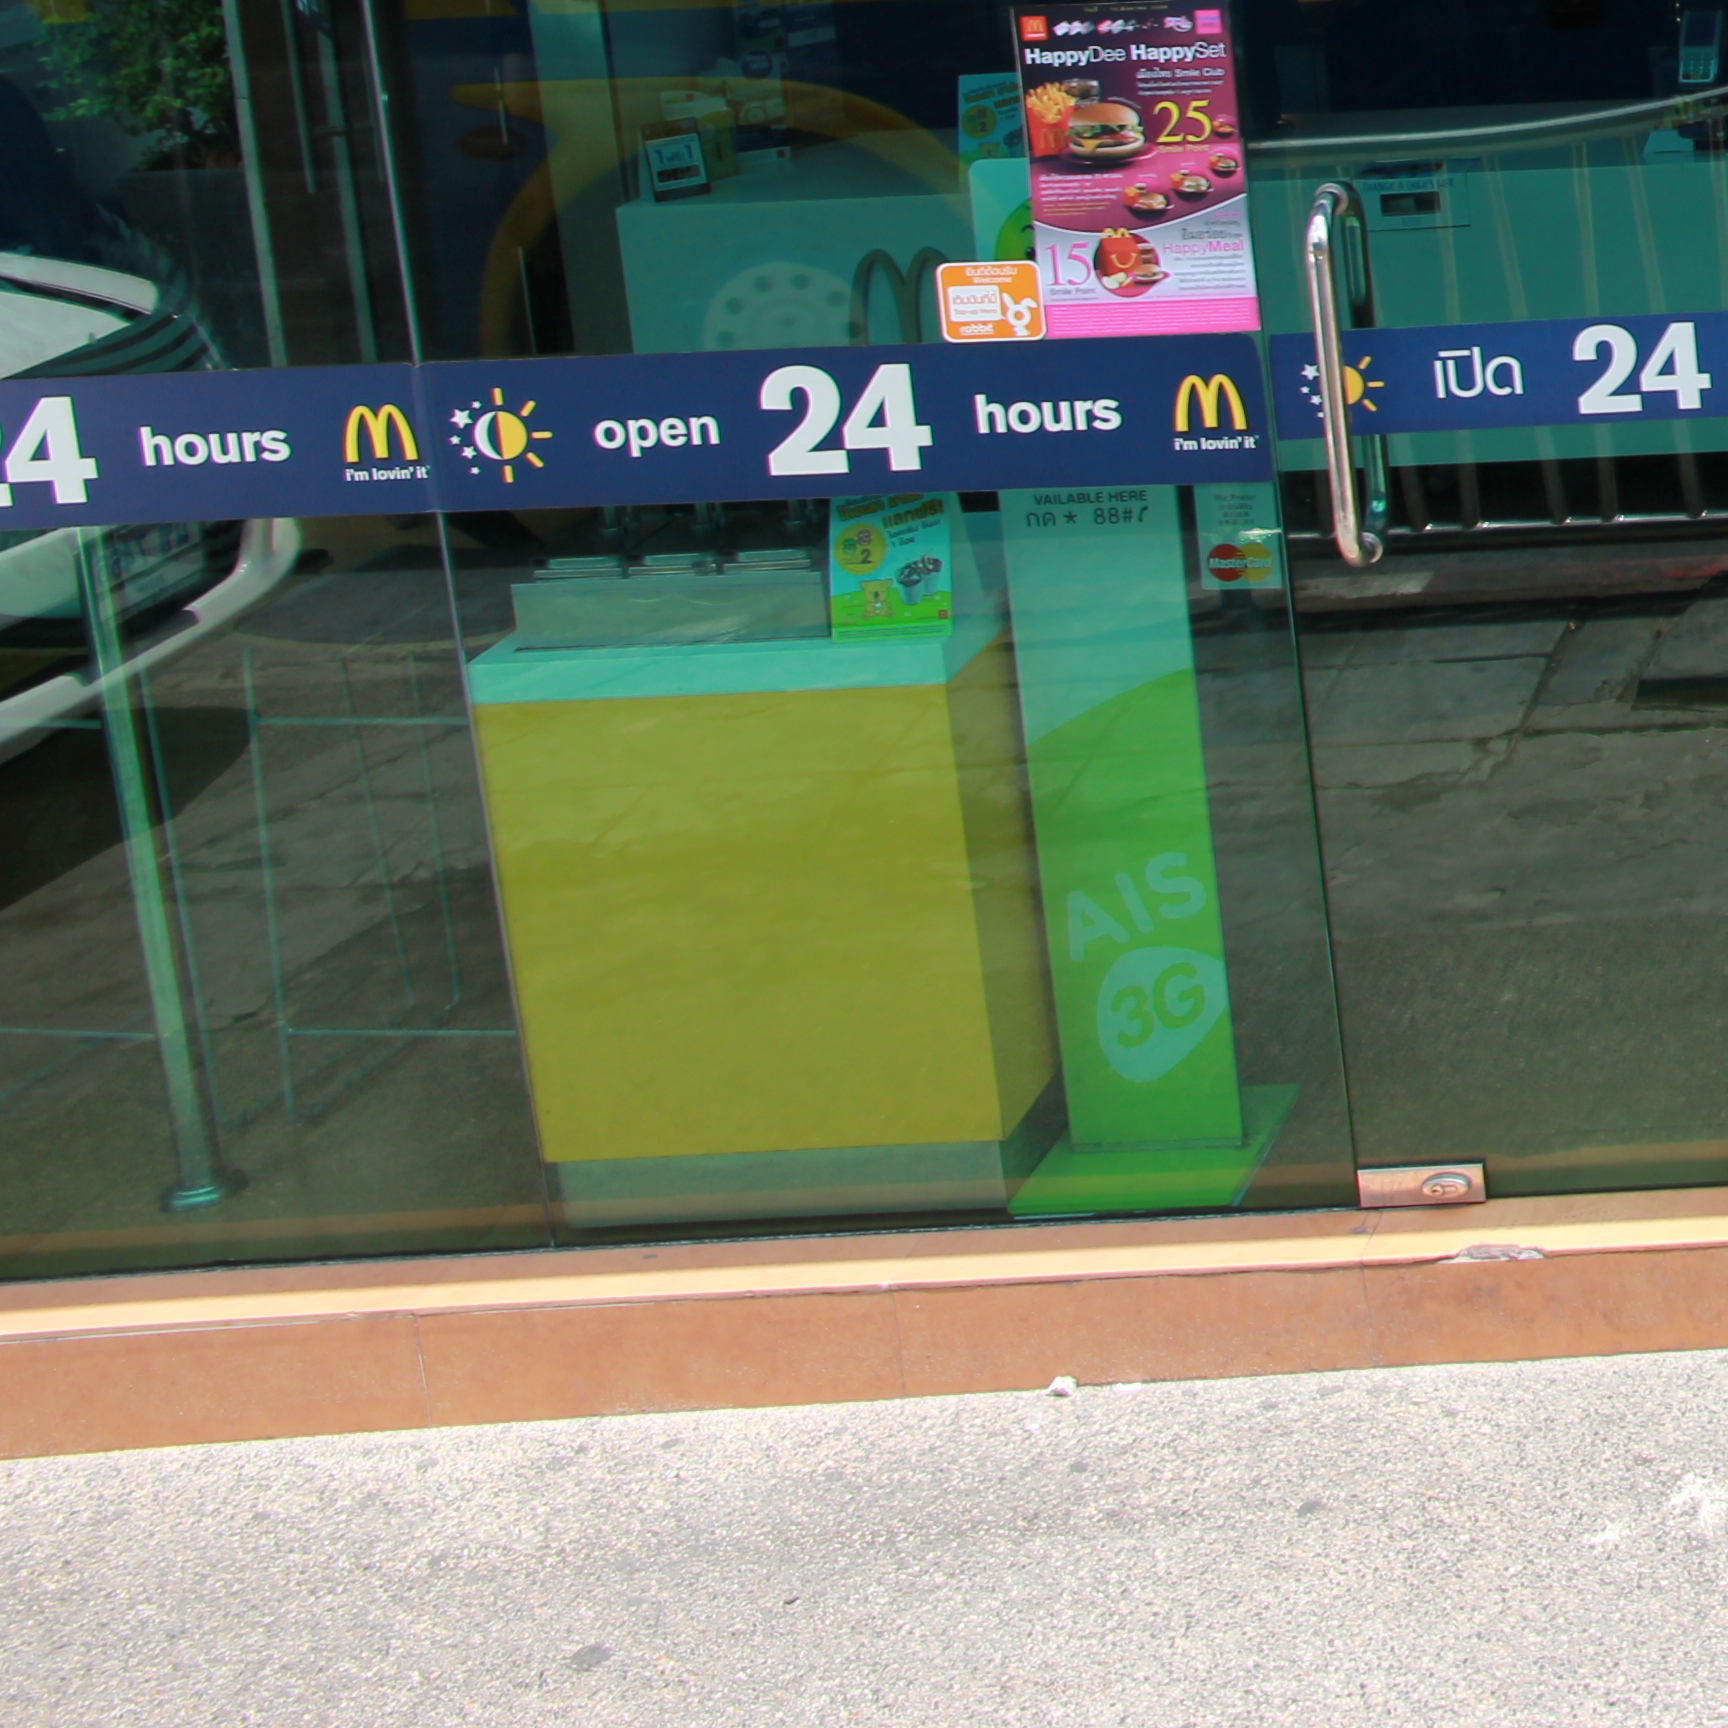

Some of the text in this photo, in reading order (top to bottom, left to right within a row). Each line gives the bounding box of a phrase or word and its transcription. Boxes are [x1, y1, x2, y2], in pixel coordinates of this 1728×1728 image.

[1024, 41, 1227, 68] HappyDee HappySet
[1152, 99, 1213, 144] 25
[1163, 240, 1244, 255] HappyMeal
[1045, 242, 1092, 286] 15
[960, 323, 995, 333] rabbit
[1433, 346, 1523, 399] เปิด
[1572, 321, 1712, 415] 24
[594, 363, 1121, 476] open 24 hours
[0, 396, 290, 508] 4 hours
[1173, 437, 1195, 451] i'm
[1243, 435, 1256, 449] it
[345, 468, 367, 482] i'm
[415, 465, 428, 479] it
[1033, 490, 1148, 506] VAILABLE HERE
[1025, 510, 1057, 528] กด
[860, 547, 873, 564] 2
[1208, 557, 1273, 570] MasterCard
[1064, 850, 1209, 965] AIS
[1109, 960, 1207, 1050] 3G
